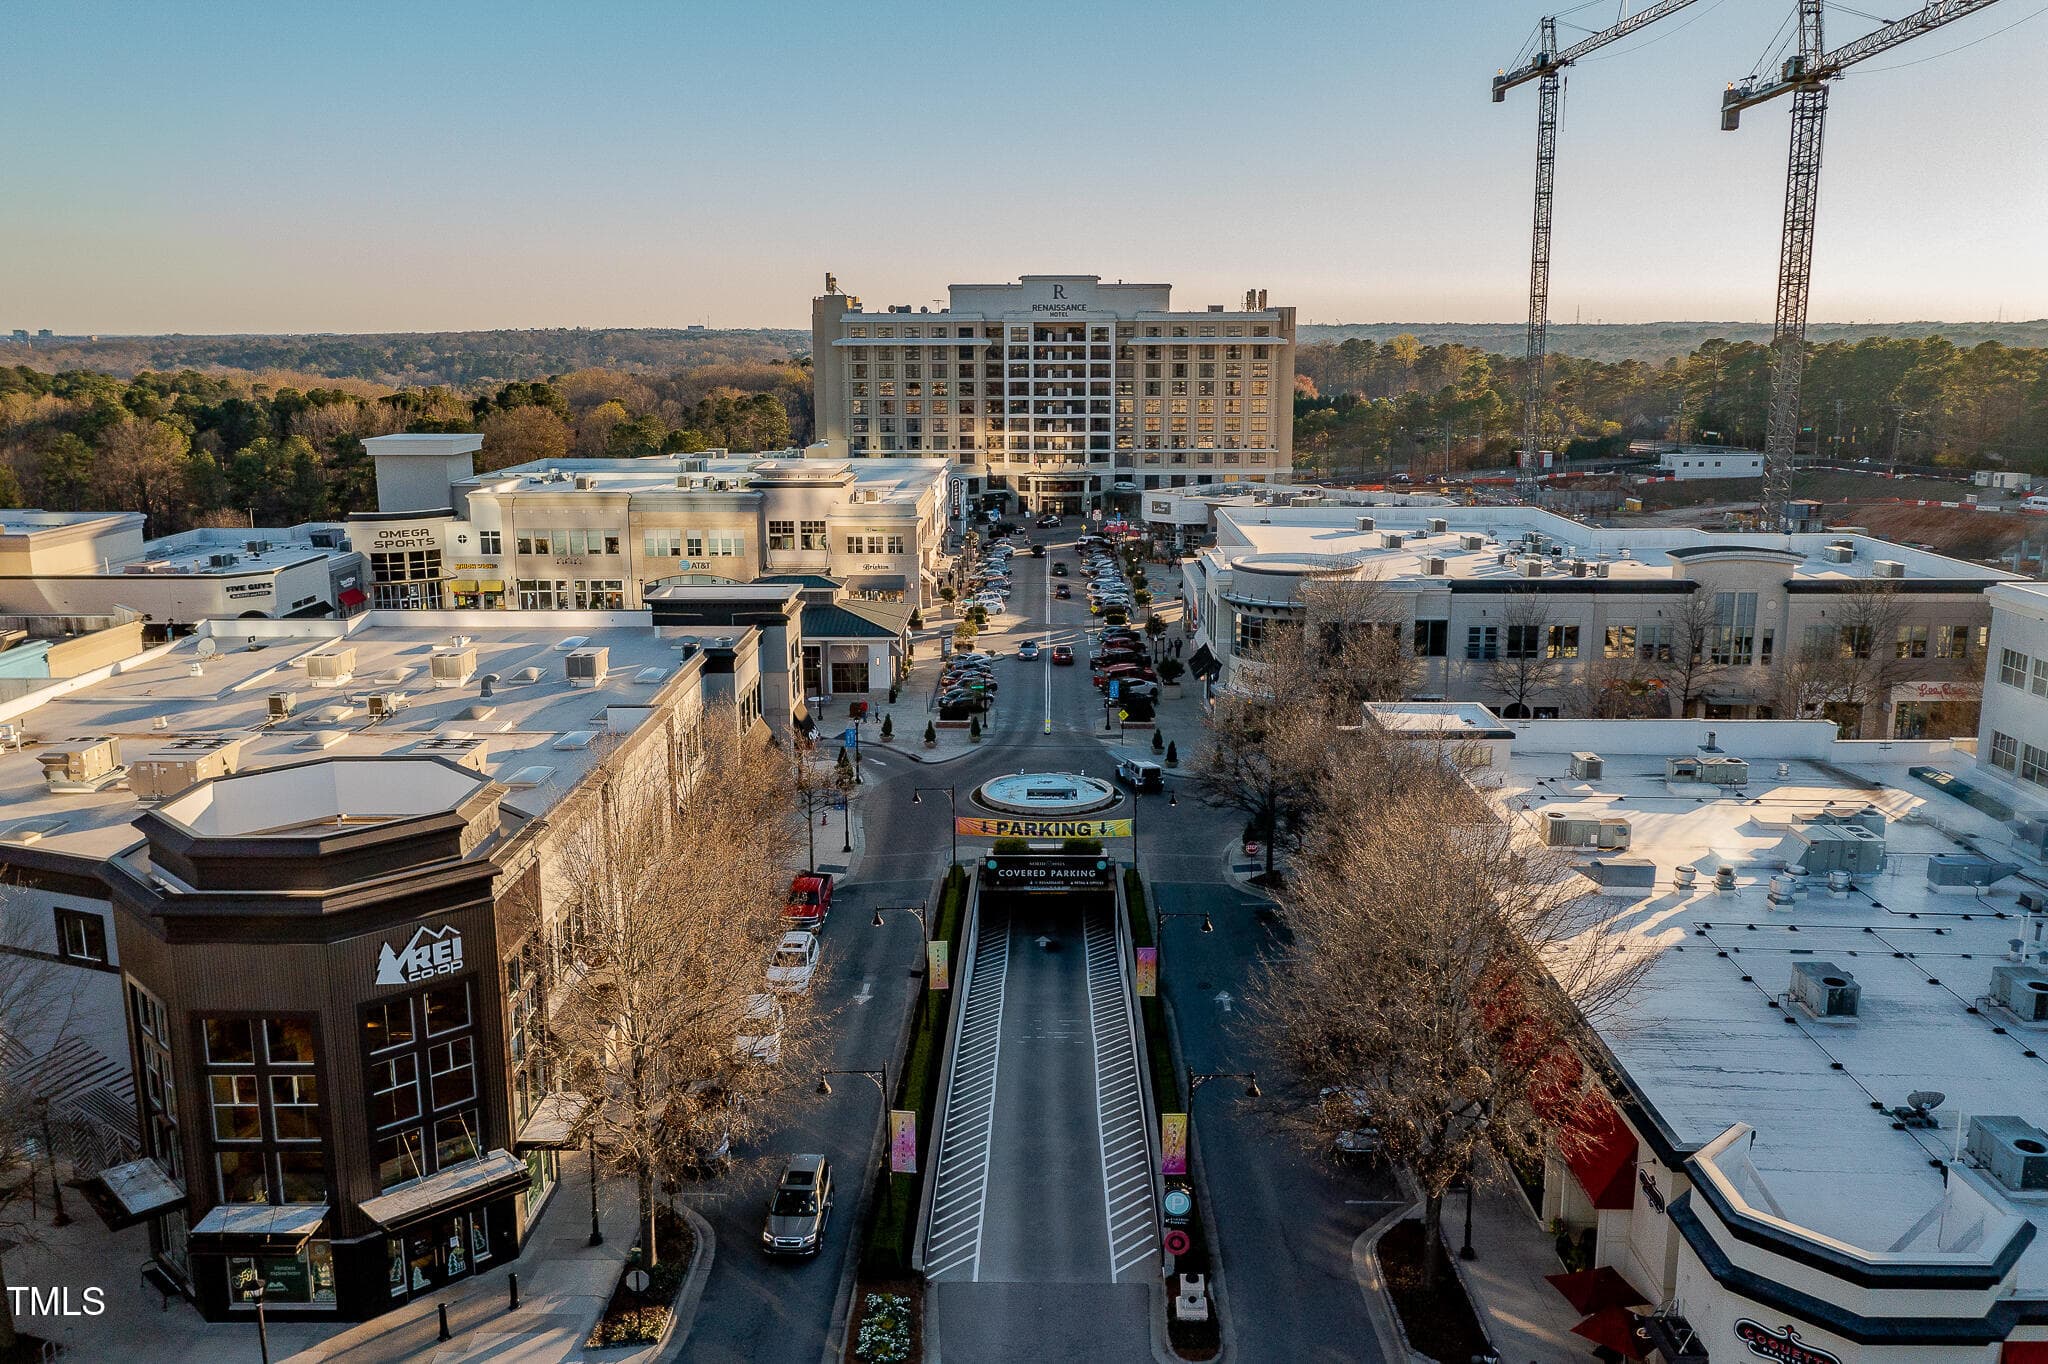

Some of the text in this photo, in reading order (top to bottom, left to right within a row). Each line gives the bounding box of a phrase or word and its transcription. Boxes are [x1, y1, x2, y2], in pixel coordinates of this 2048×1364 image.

[1053, 284, 1068, 299] R
[1032, 303, 1087, 311] RENAISSANCE
[378, 528, 430, 539] OMEGA
[373, 537, 436, 549] SPORTS
[691, 561, 711, 570] AT&T
[226, 582, 273, 593] FIVE GUYS
[996, 821, 1092, 836] PARKING
[998, 869, 1096, 877] COVERED PARKING
[407, 936, 463, 973] REI
[1171, 1195, 1185, 1211] P
